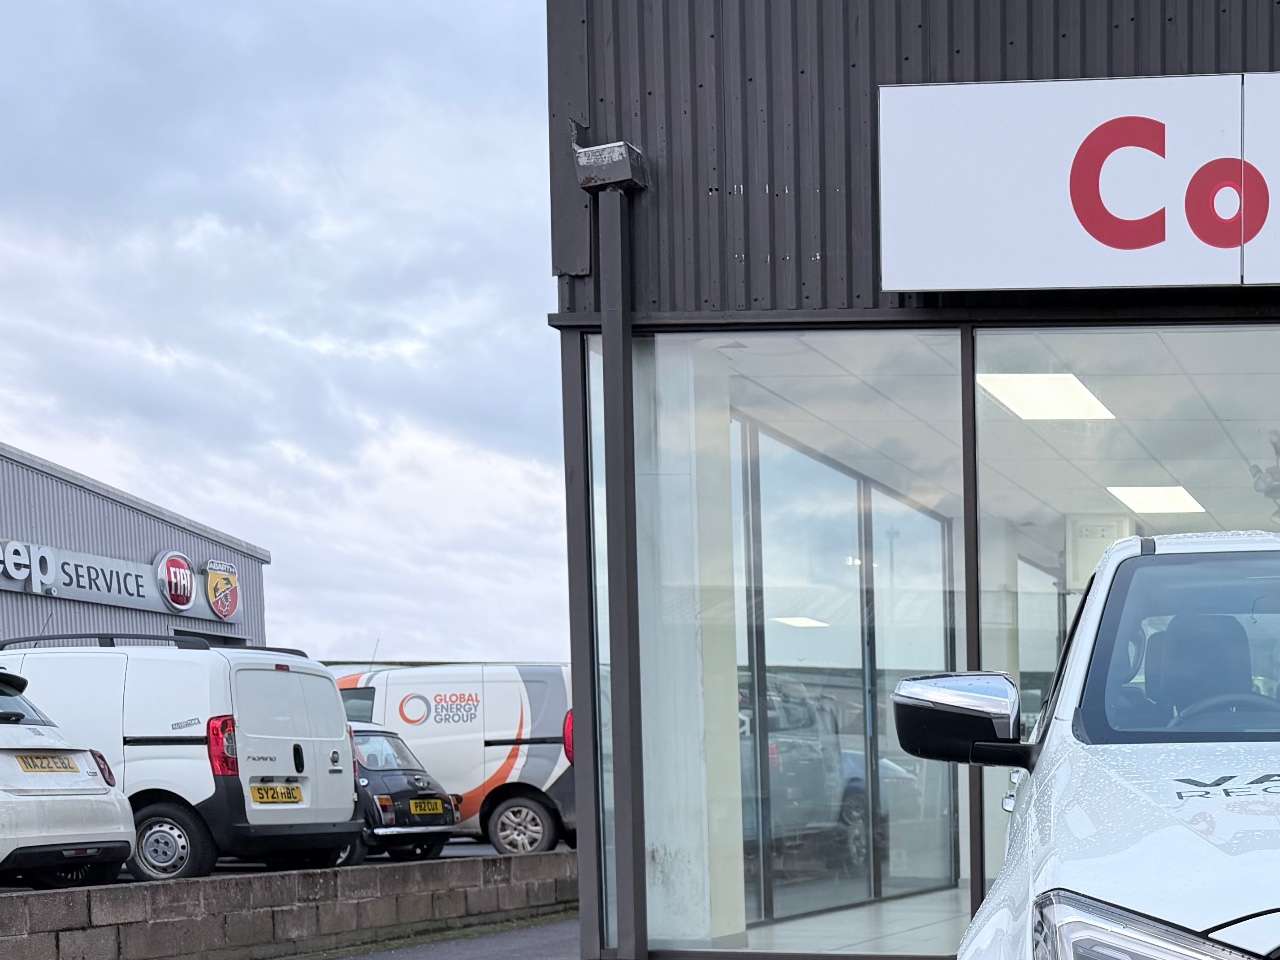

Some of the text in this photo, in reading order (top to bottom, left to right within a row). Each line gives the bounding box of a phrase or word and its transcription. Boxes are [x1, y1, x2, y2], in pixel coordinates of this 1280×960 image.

[0, 541, 147, 599] ep SERVICE
[170, 566, 192, 598] FIAT
[433, 693, 481, 704] GLOBAL
[434, 703, 480, 714] ENERGY
[433, 712, 477, 724] GROUP
